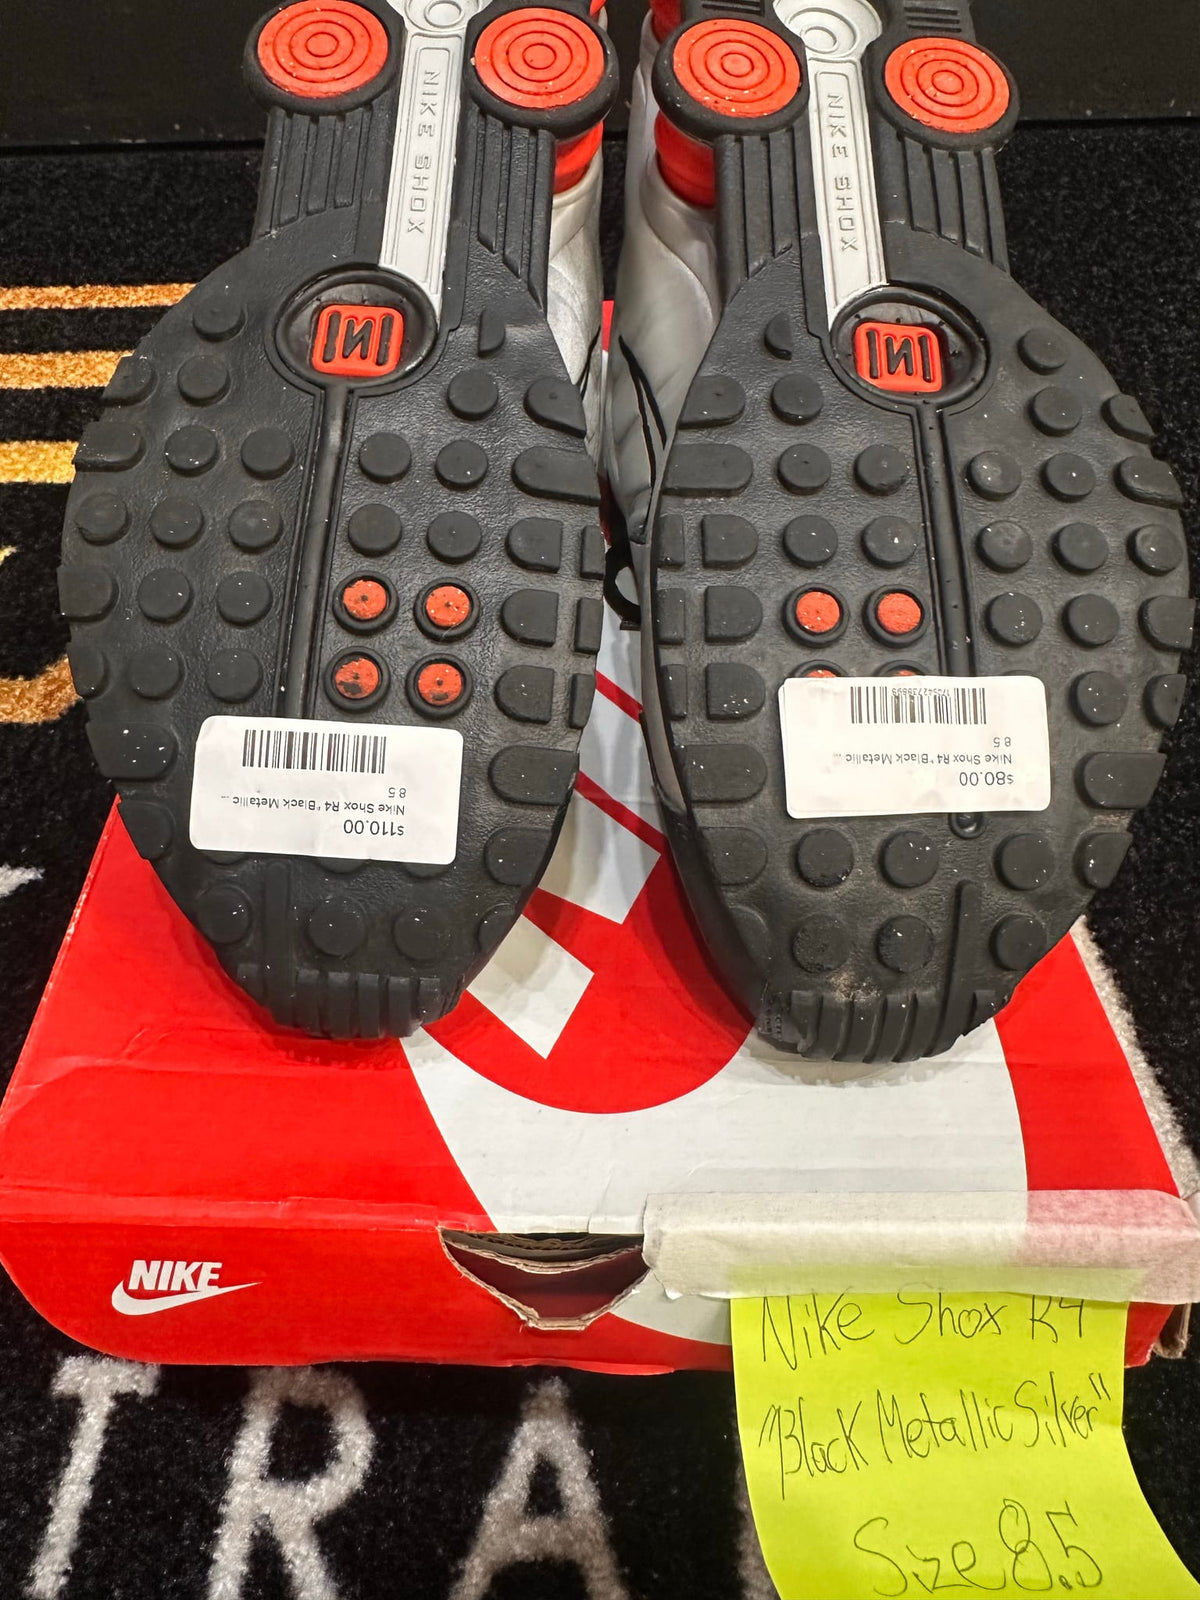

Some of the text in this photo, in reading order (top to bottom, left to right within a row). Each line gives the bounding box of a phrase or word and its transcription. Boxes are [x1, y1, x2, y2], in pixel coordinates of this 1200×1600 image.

[407, 70, 441, 234] NIKE SHOX
[827, 94, 859, 252] NIKE SHOX
[845, 752, 893, 764] Metallic
[936, 753, 950, 765] R4
[953, 753, 981, 765] Shox
[984, 753, 1012, 765] Nike
[958, 771, 1015, 787] $80.00
[232, 796, 279, 809] Metallic
[324, 799, 340, 812] R4
[344, 801, 375, 813] Shox
[378, 803, 405, 816] Nike
[342, 818, 405, 837] $110.00
[127, 1259, 223, 1291] NIKE
[894, 1282, 1008, 1345] Shox
[1029, 1294, 1084, 1344] R4
[876, 1388, 1014, 1465] Metallic
[853, 1498, 1103, 1598] Size 8.5
